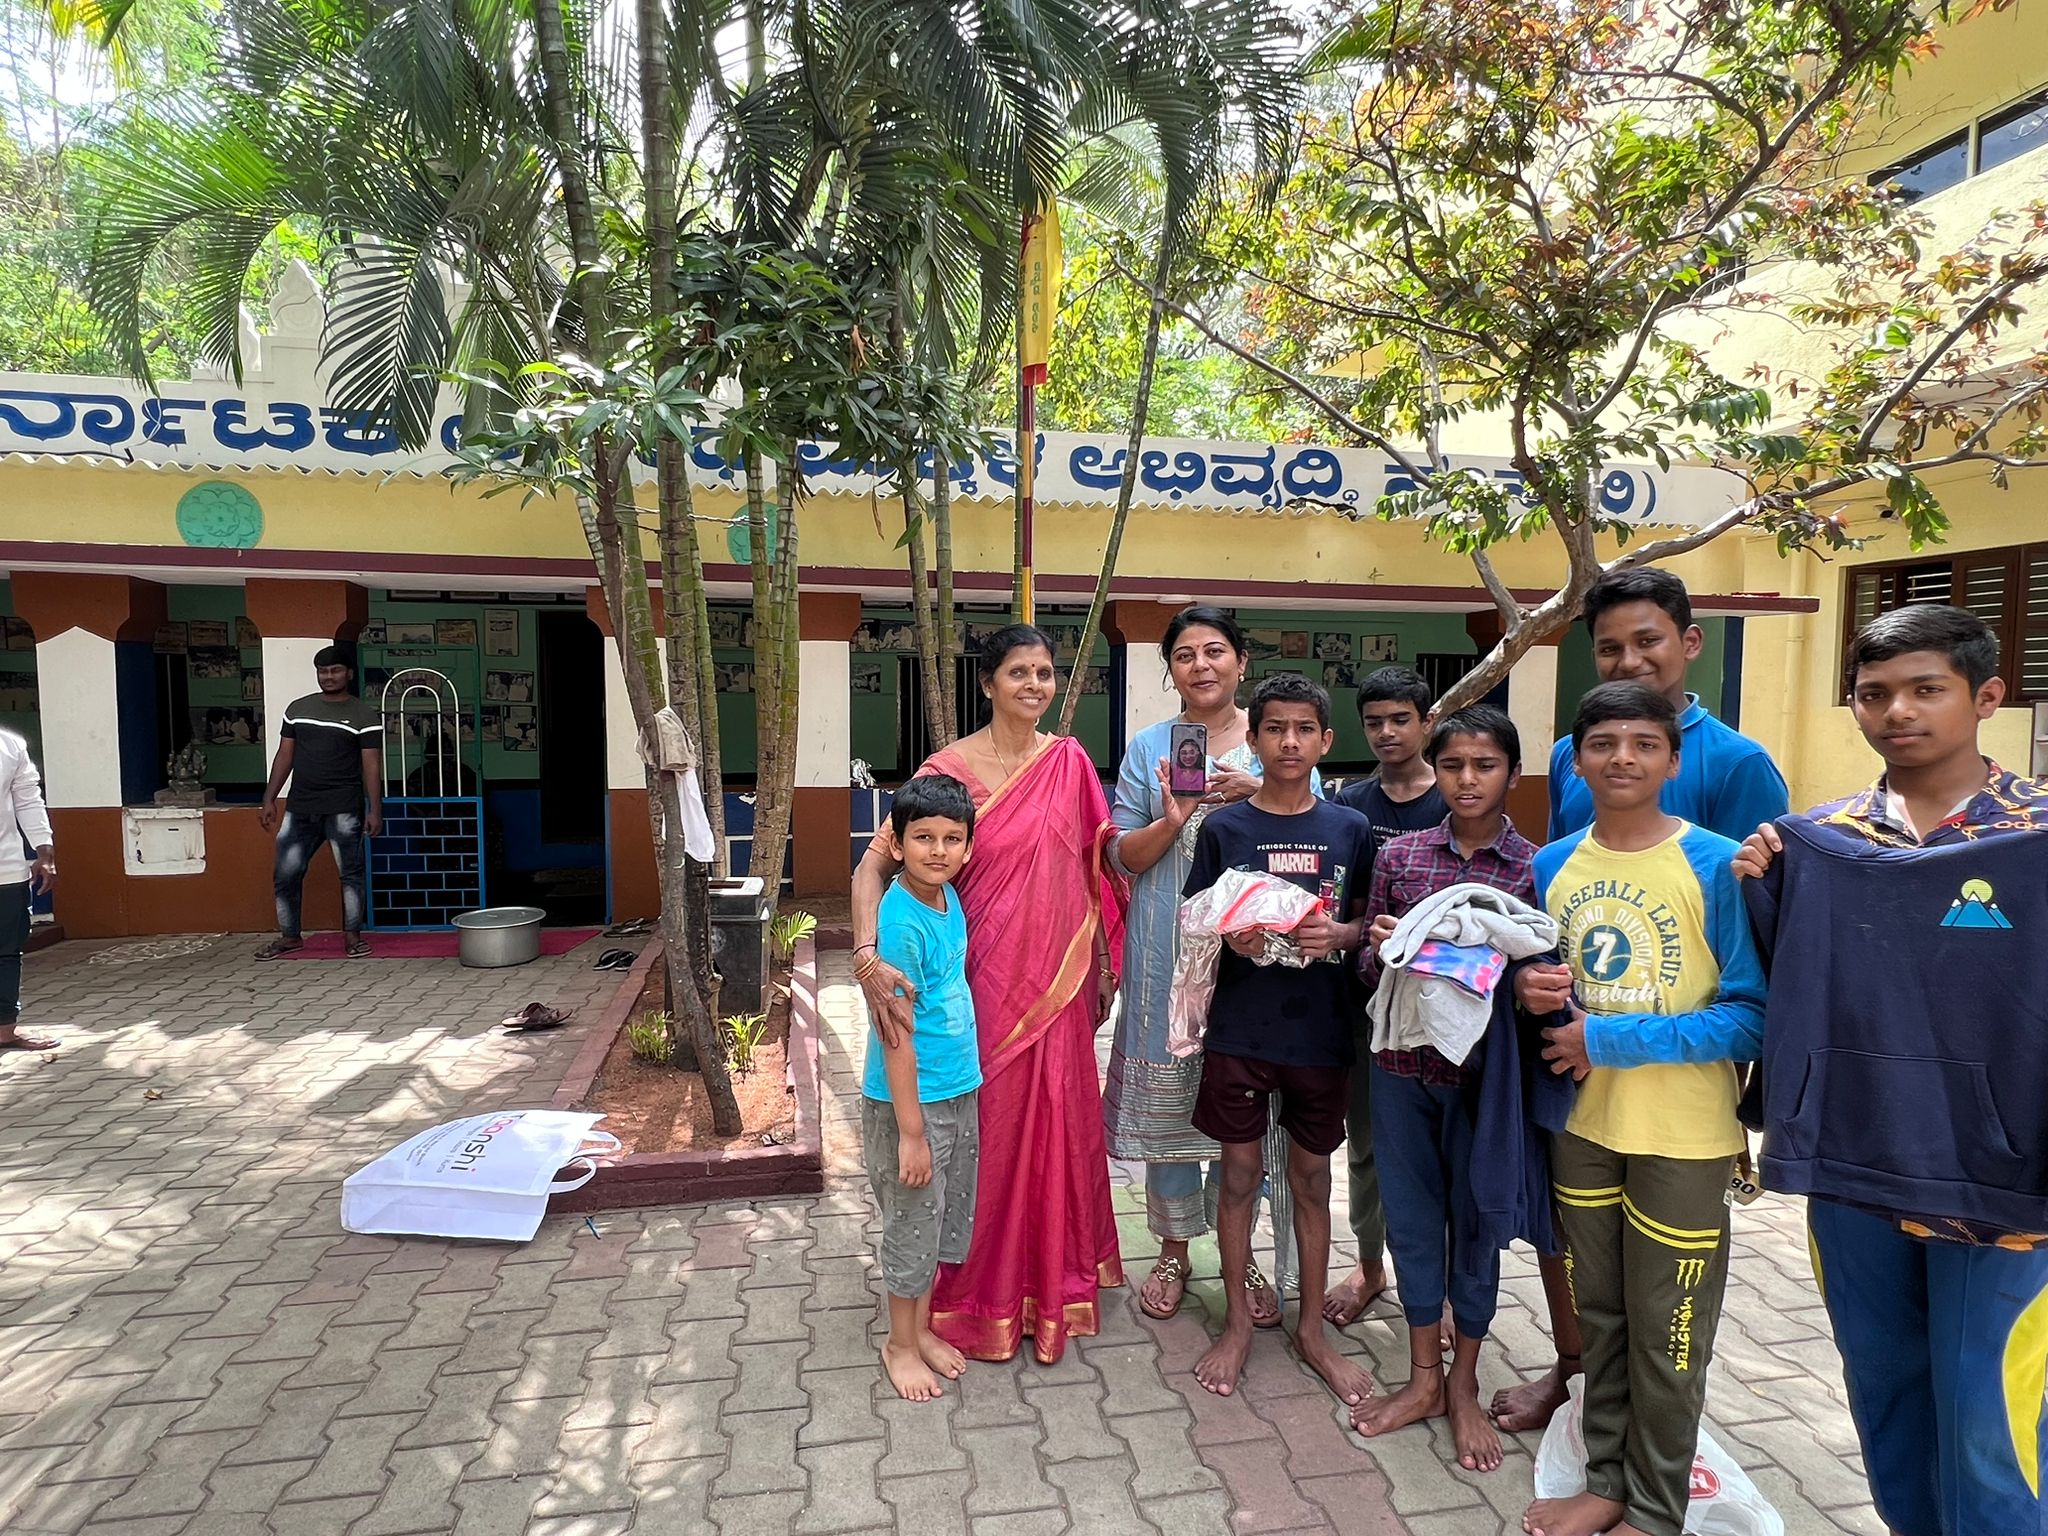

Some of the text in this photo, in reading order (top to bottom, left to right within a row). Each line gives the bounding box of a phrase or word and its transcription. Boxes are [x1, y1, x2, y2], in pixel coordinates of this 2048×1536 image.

[1256, 843, 1292, 851] PERIODIC
[1268, 853, 1318, 873] MARVEL
[1559, 880, 1682, 988] BASEBALL LEAGUE
[1592, 931, 1617, 974] 7
[1614, 907, 1654, 968] DIVISION
[1667, 1308, 1679, 1357] ENERGY
[1675, 1296, 1694, 1372] MONSTER
